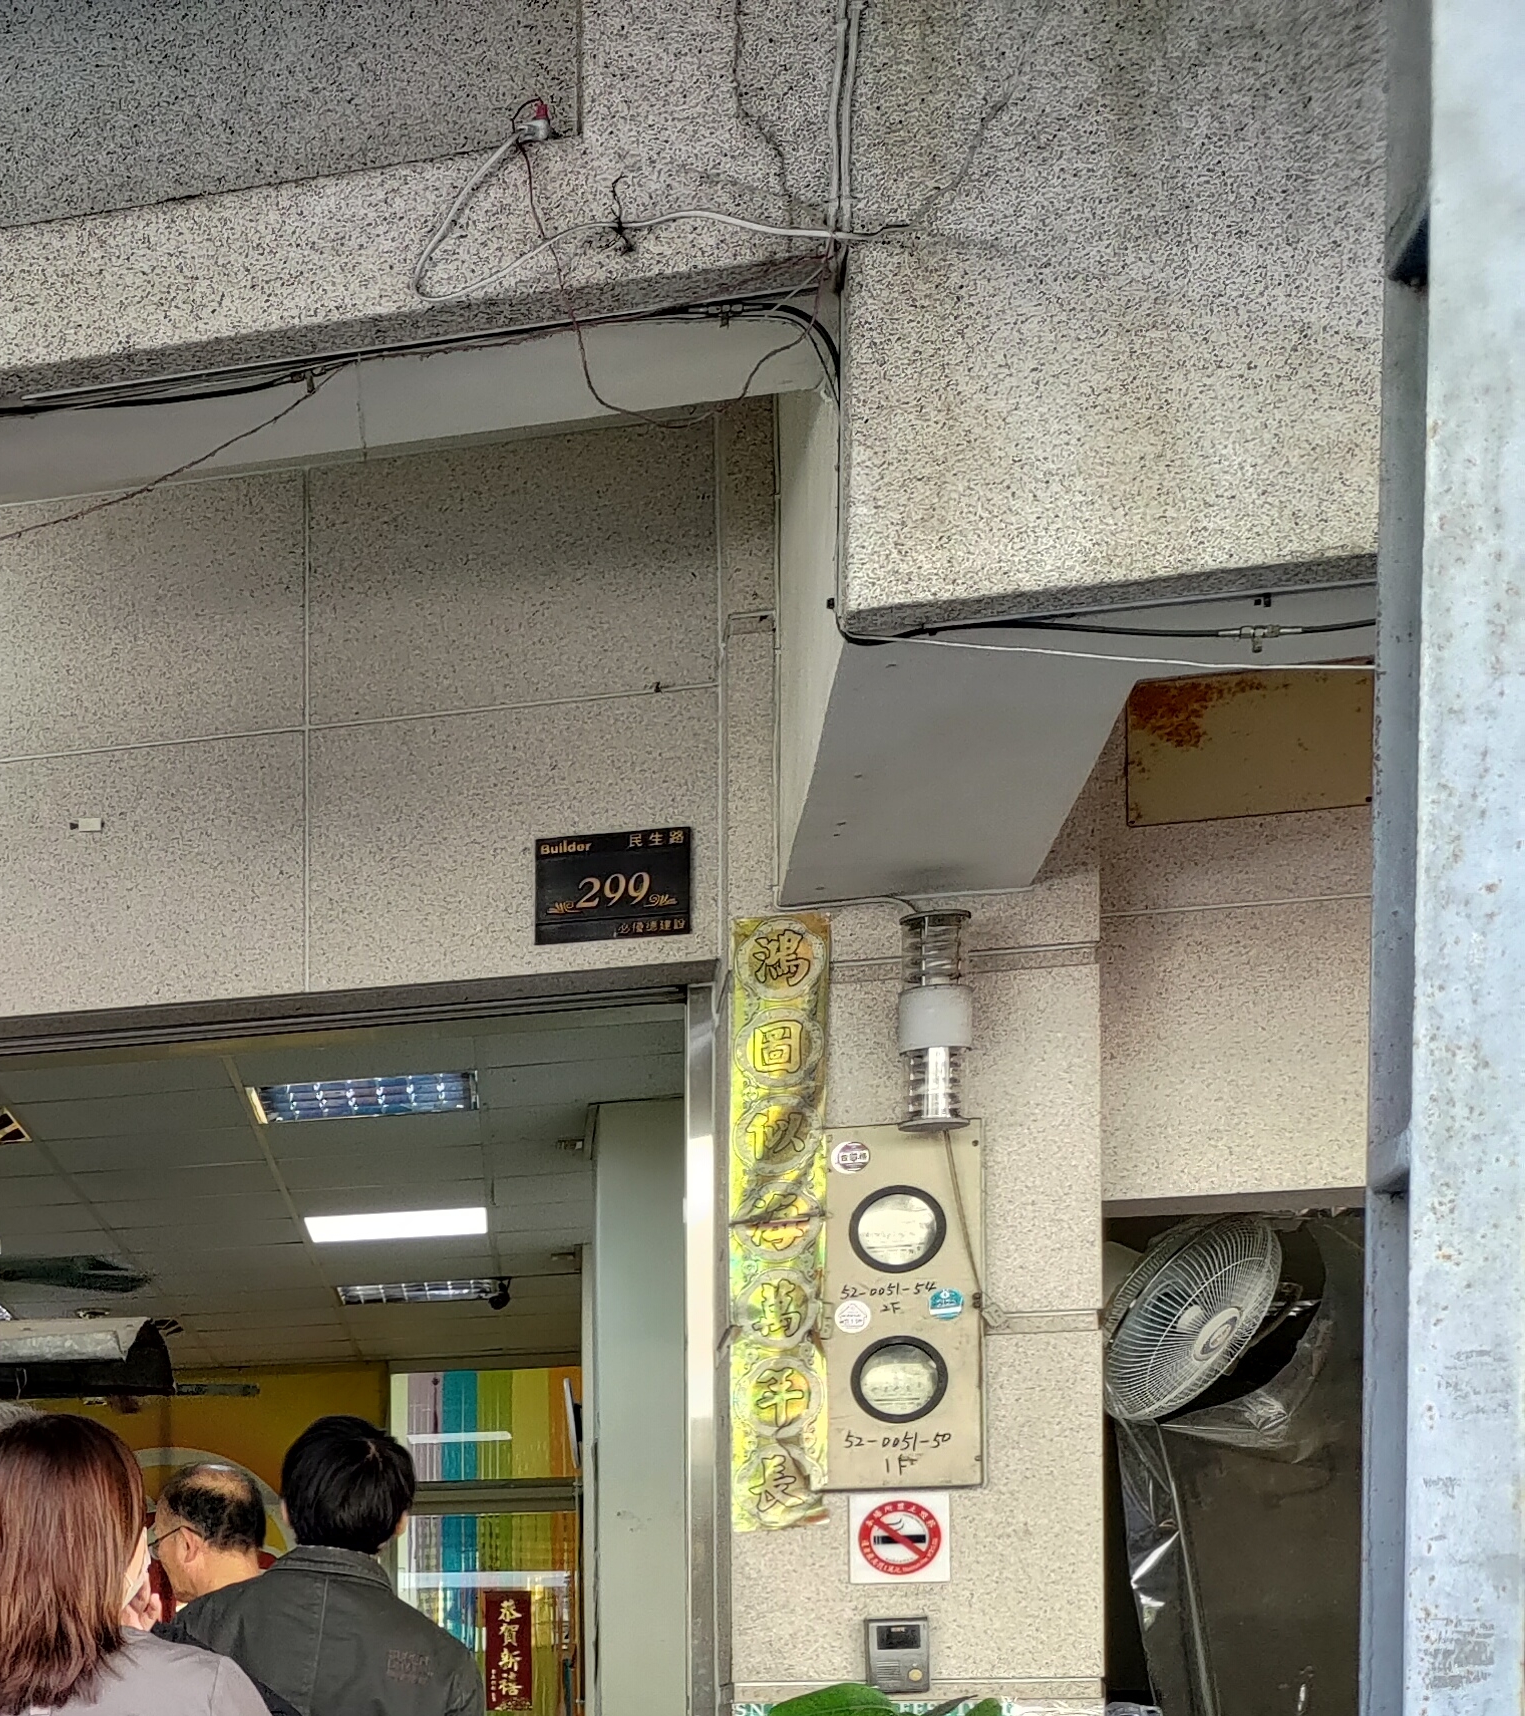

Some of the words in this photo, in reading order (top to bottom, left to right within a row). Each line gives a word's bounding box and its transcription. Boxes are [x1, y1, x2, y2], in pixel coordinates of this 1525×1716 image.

[629, 830, 684, 848] 民生路
[576, 872, 650, 908] 299
[497, 1599, 523, 1696] 恭賀新禧
